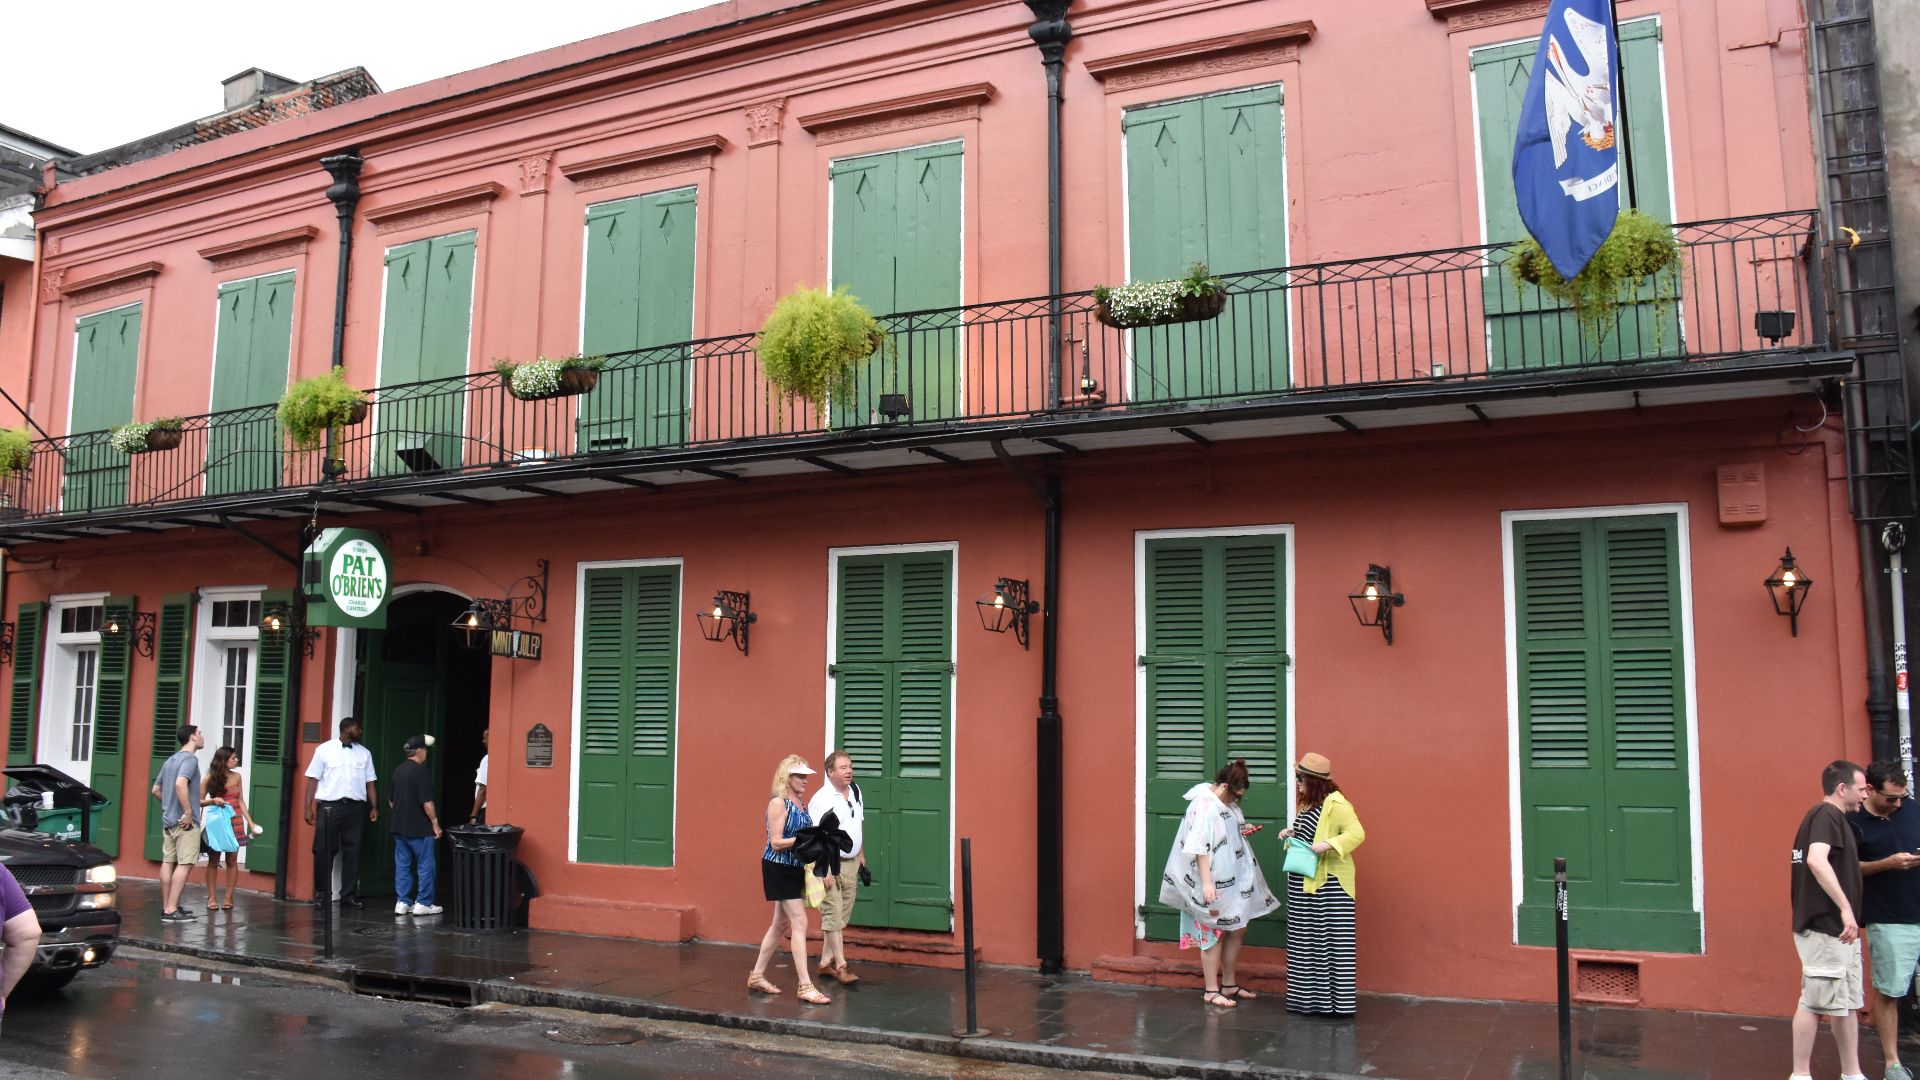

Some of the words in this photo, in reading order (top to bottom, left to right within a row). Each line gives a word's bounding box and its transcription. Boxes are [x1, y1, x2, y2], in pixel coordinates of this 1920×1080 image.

[343, 554, 376, 576] PAT
[333, 575, 382, 599] O'BRIEN'S
[492, 631, 512, 653] MINT
[518, 635, 540, 657] JULEP
